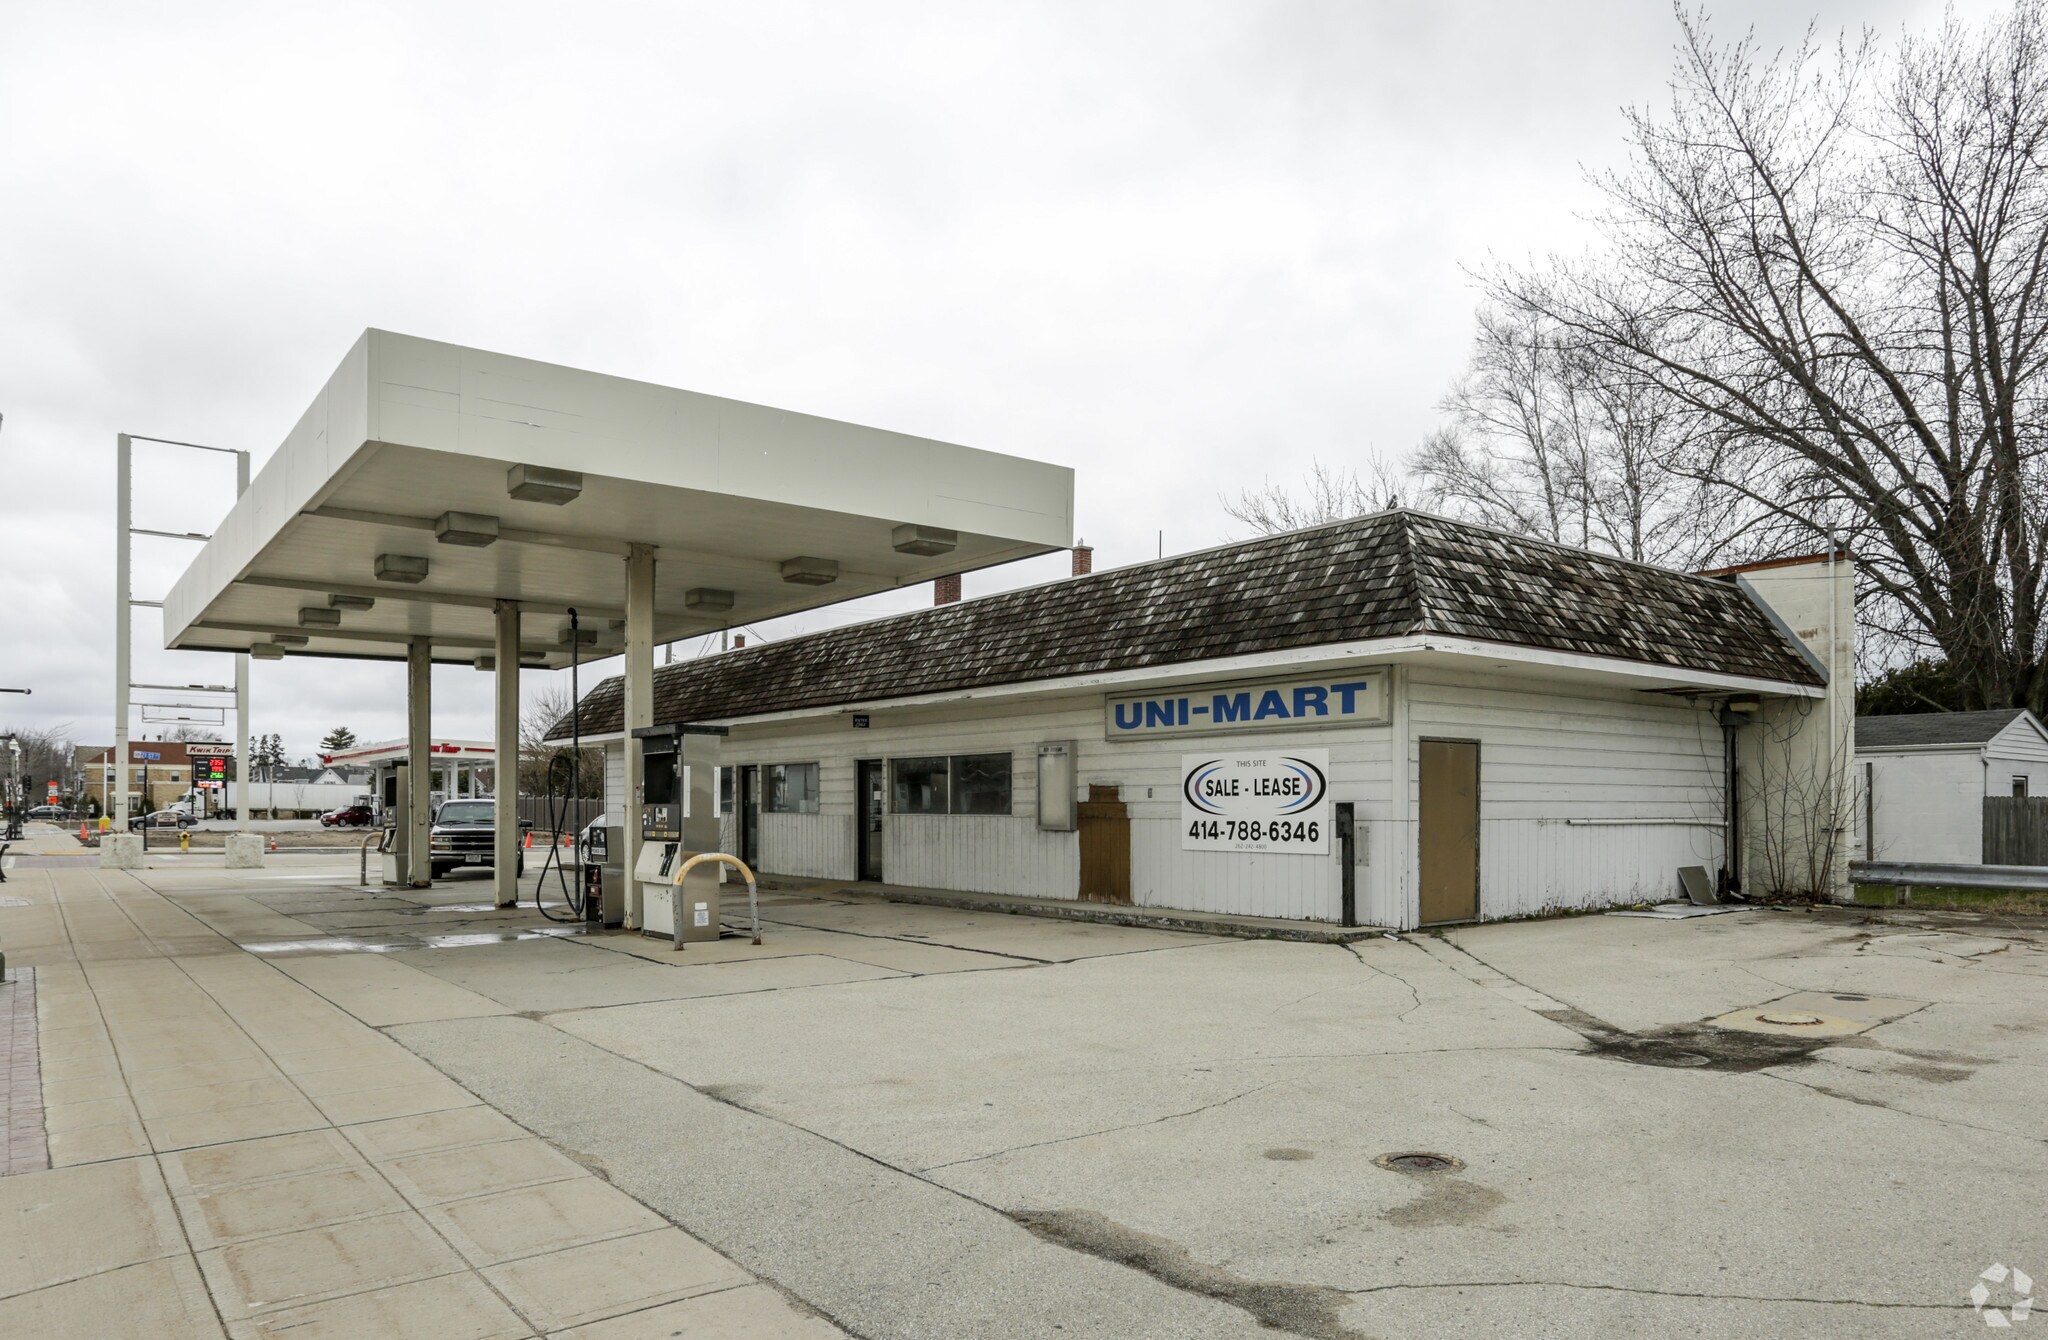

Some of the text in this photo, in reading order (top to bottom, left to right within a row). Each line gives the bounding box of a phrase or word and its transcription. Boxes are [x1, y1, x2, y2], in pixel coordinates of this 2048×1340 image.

[1115, 682, 1367, 730] UNI-MART
[1236, 759, 1267, 768] THIS SITE
[1205, 778, 1239, 797] SALE
[1254, 777, 1301, 797] LEASE
[1189, 820, 1319, 842] 414-788-6346
